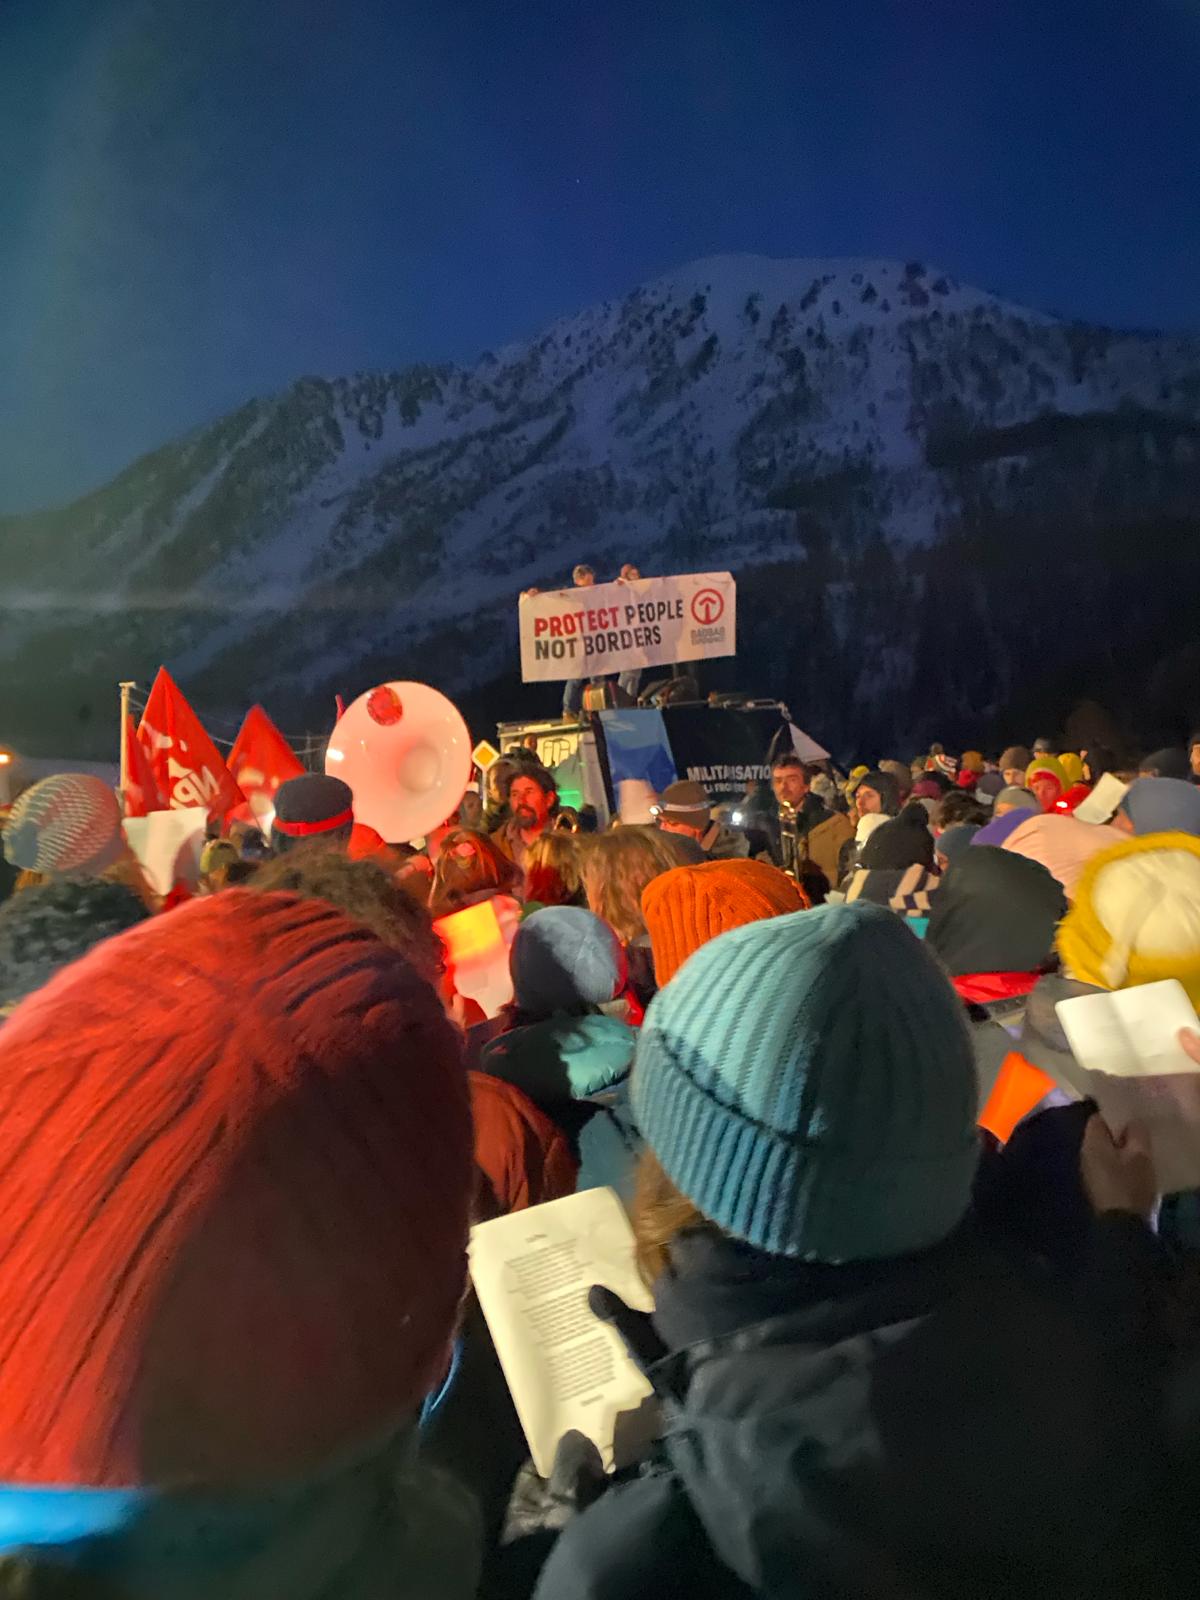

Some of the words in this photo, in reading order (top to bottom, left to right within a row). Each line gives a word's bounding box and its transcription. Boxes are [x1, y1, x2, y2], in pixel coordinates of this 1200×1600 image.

[534, 606, 619, 637] PROTECT
[625, 599, 683, 625] PEOPLE
[535, 638, 577, 660] NOT
[584, 625, 662, 656] BORDERS
[687, 764, 771, 781] MILITAISATIO
